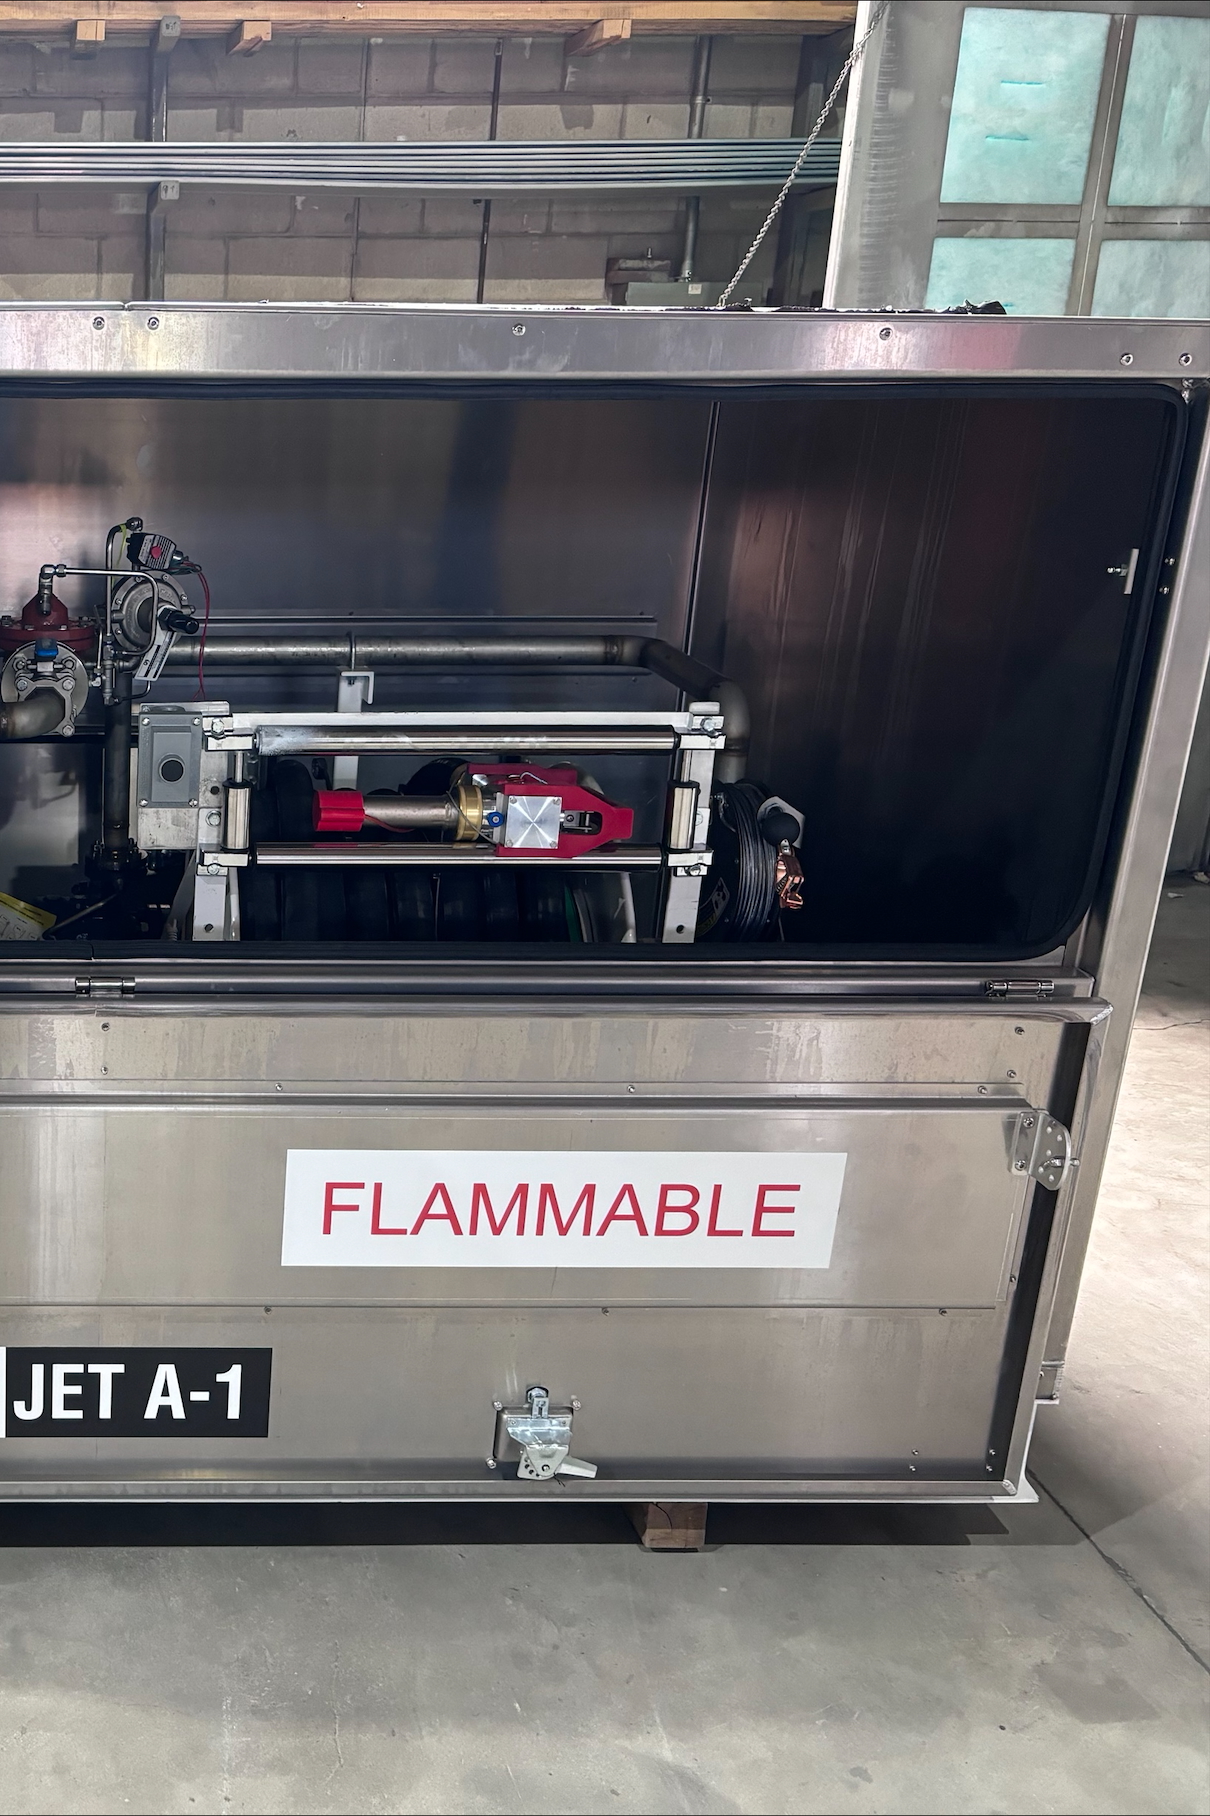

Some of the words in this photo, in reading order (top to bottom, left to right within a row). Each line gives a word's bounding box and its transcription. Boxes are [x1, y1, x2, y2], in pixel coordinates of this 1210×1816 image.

[322, 1181, 801, 1238] FLAMMABLE
[13, 1363, 125, 1421] JET
[143, 1363, 242, 1420] A-1
